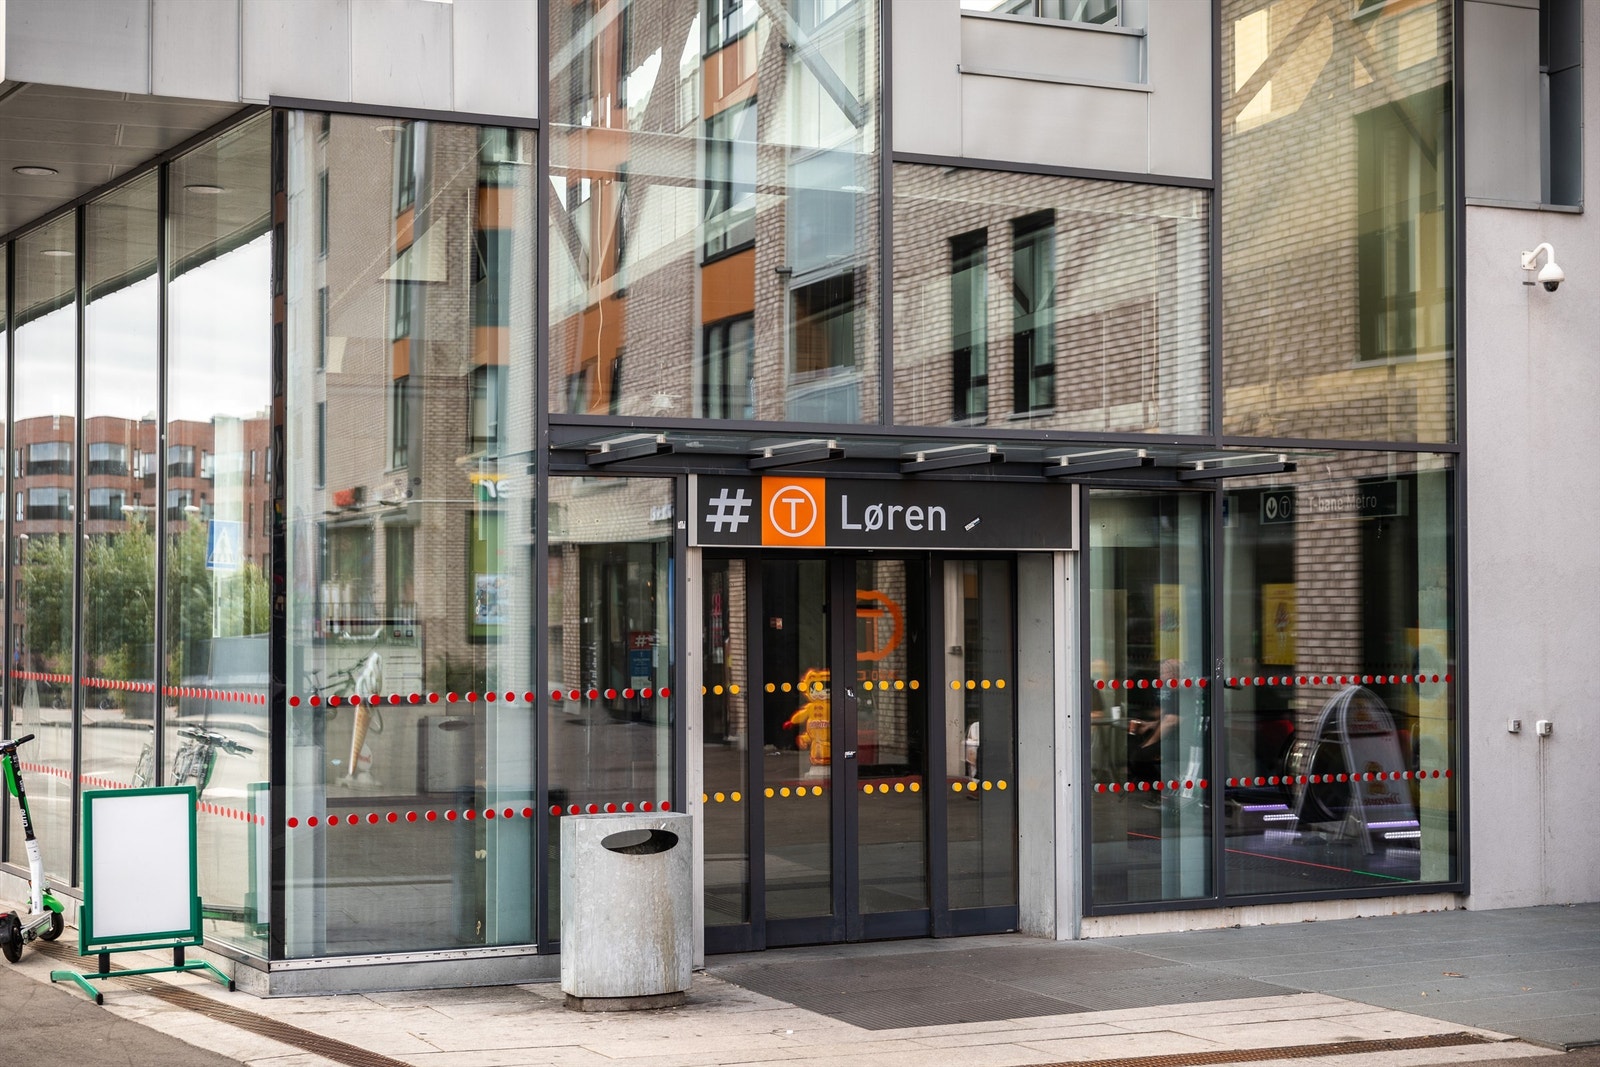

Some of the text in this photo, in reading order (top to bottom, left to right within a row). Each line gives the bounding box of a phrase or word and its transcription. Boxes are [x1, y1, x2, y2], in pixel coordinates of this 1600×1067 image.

[841, 494, 947, 532] Løren
[1308, 496, 1344, 513] T-bane
[1346, 494, 1377, 510] Metro
